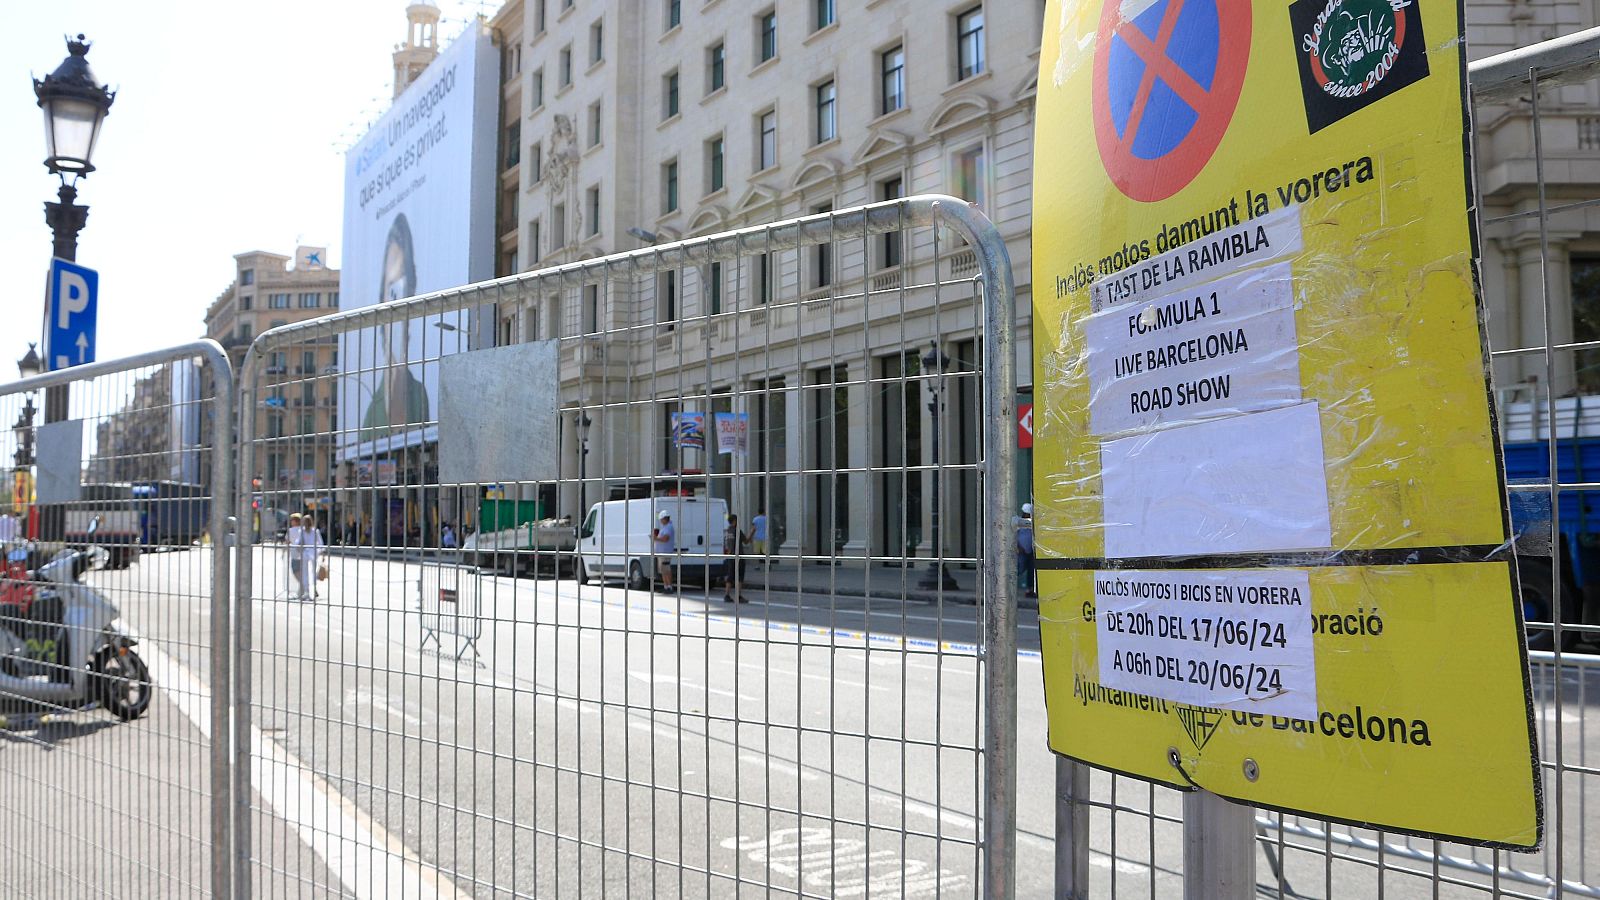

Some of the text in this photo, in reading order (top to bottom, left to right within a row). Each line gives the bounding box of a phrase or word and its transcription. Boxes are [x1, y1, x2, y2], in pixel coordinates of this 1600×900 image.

[1323, 41, 1399, 97] since 2004
[402, 63, 457, 133] navegador
[359, 179, 375, 212] que
[385, 155, 402, 191] que
[1056, 156, 1374, 299] Inclòs motos damunt la vorera
[1106, 225, 1270, 303] TAST DE LA RAMBLA
[58, 269, 89, 329] P
[1210, 292, 1221, 316] 1
[1115, 328, 1249, 379] LIVE BARCELONA
[1131, 374, 1230, 414] ROAD SHOW
[1096, 577, 1302, 606] INCLÒS MOTOS I BICIS EN VORERA
[1107, 611, 1124, 633] DE
[1127, 612, 1154, 636] 20h
[1158, 615, 1187, 640] DEL
[1191, 616, 1287, 651] 17/06/24
[1113, 649, 1283, 695] A 06h DEL 20/06/24
